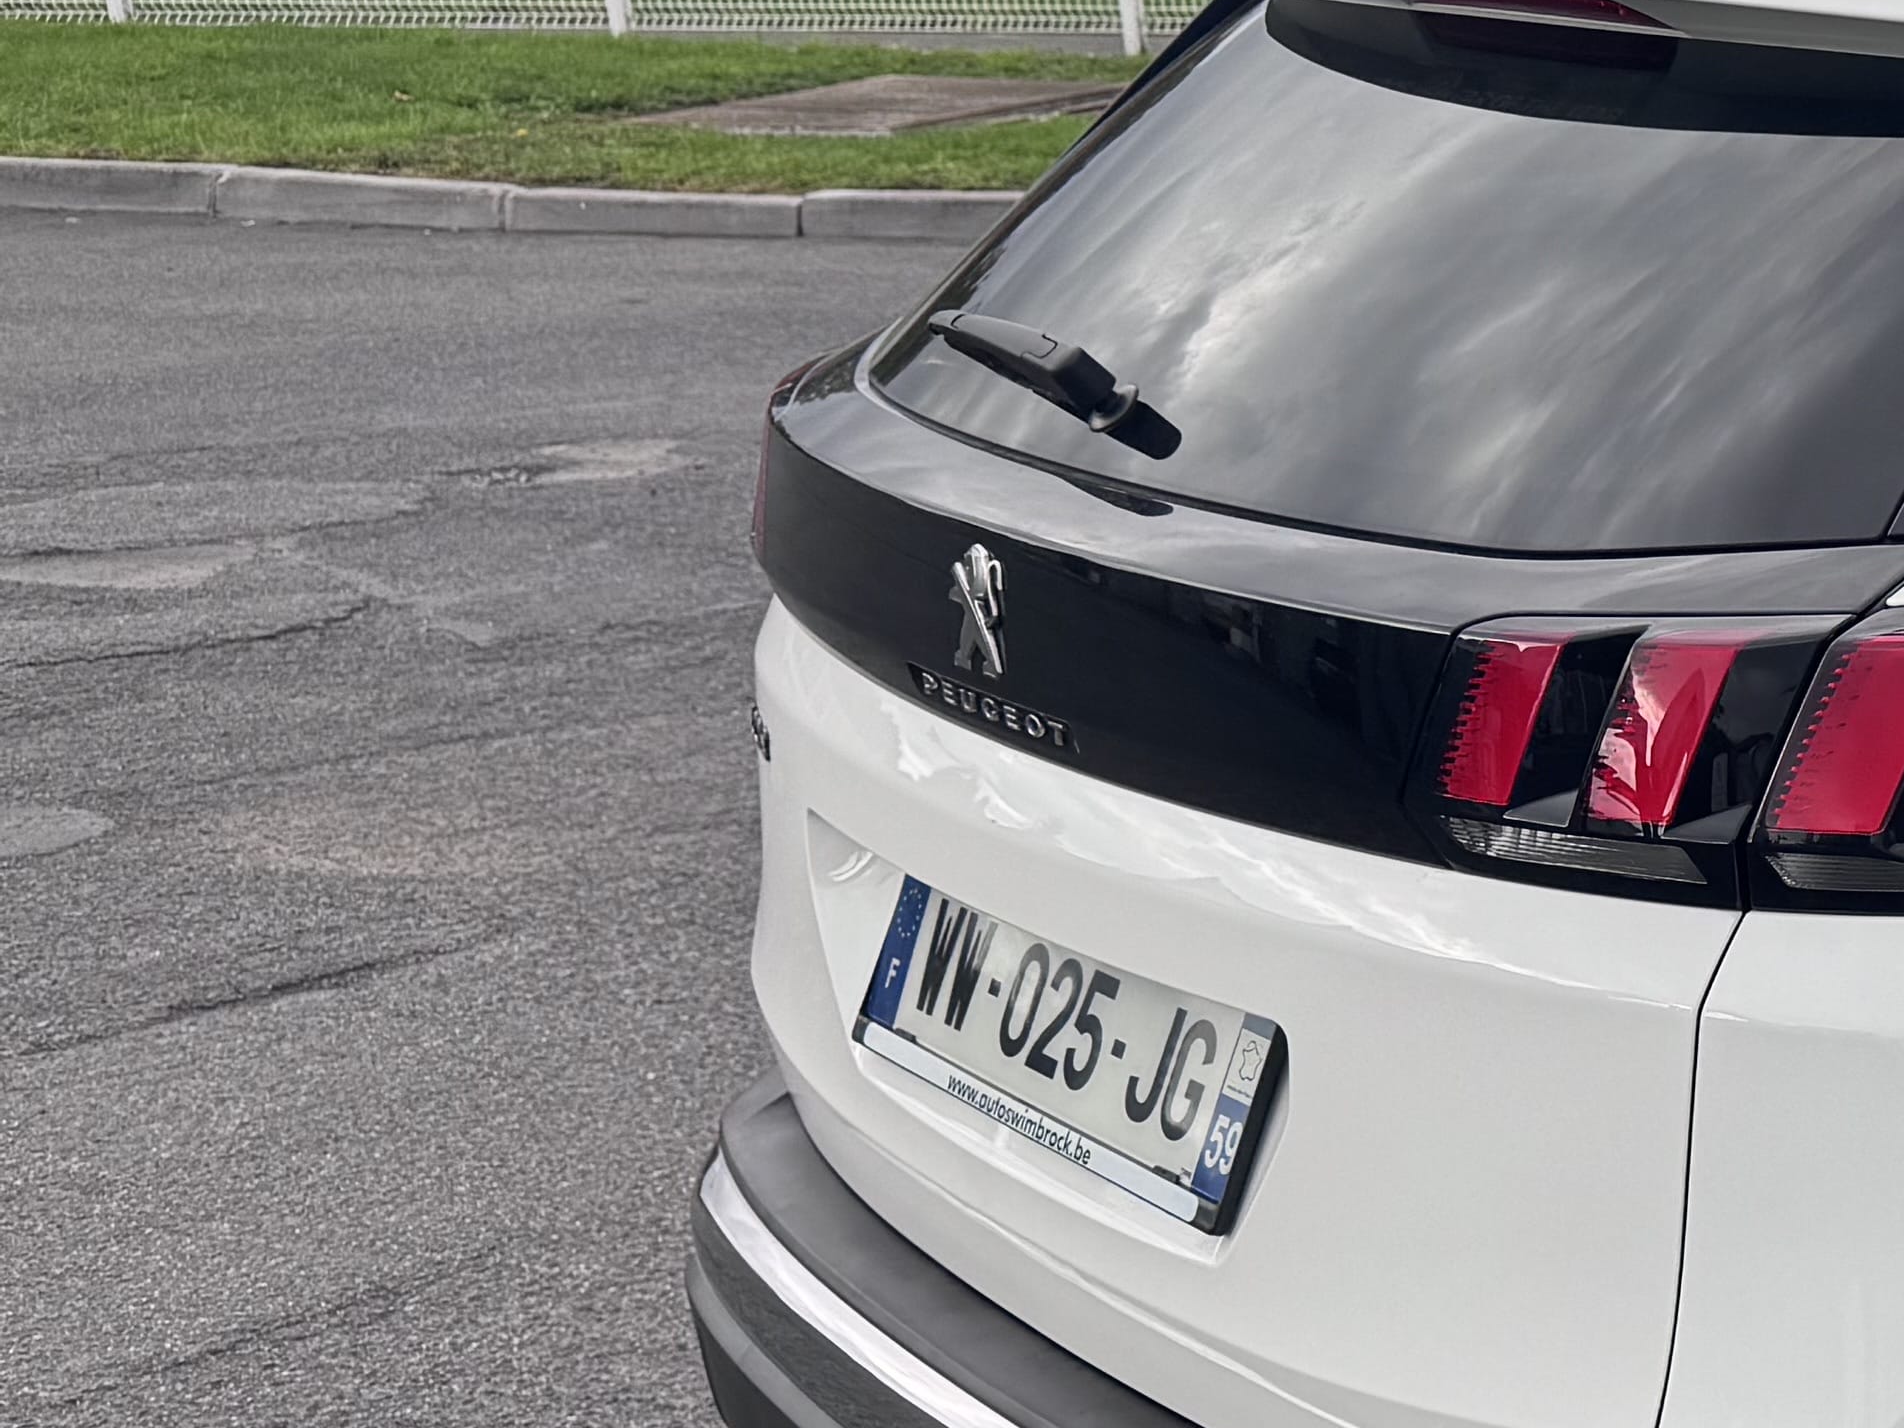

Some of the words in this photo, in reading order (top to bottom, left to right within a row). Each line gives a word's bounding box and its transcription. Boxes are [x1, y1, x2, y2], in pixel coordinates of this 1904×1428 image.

[921, 671, 1069, 747] PEUGEOT
[885, 957, 900, 988] F
[916, 898, 1218, 1141] WW-025-JG
[946, 1075, 1091, 1164] www.autoswimbrock.be
[1204, 1114, 1243, 1175] 59
